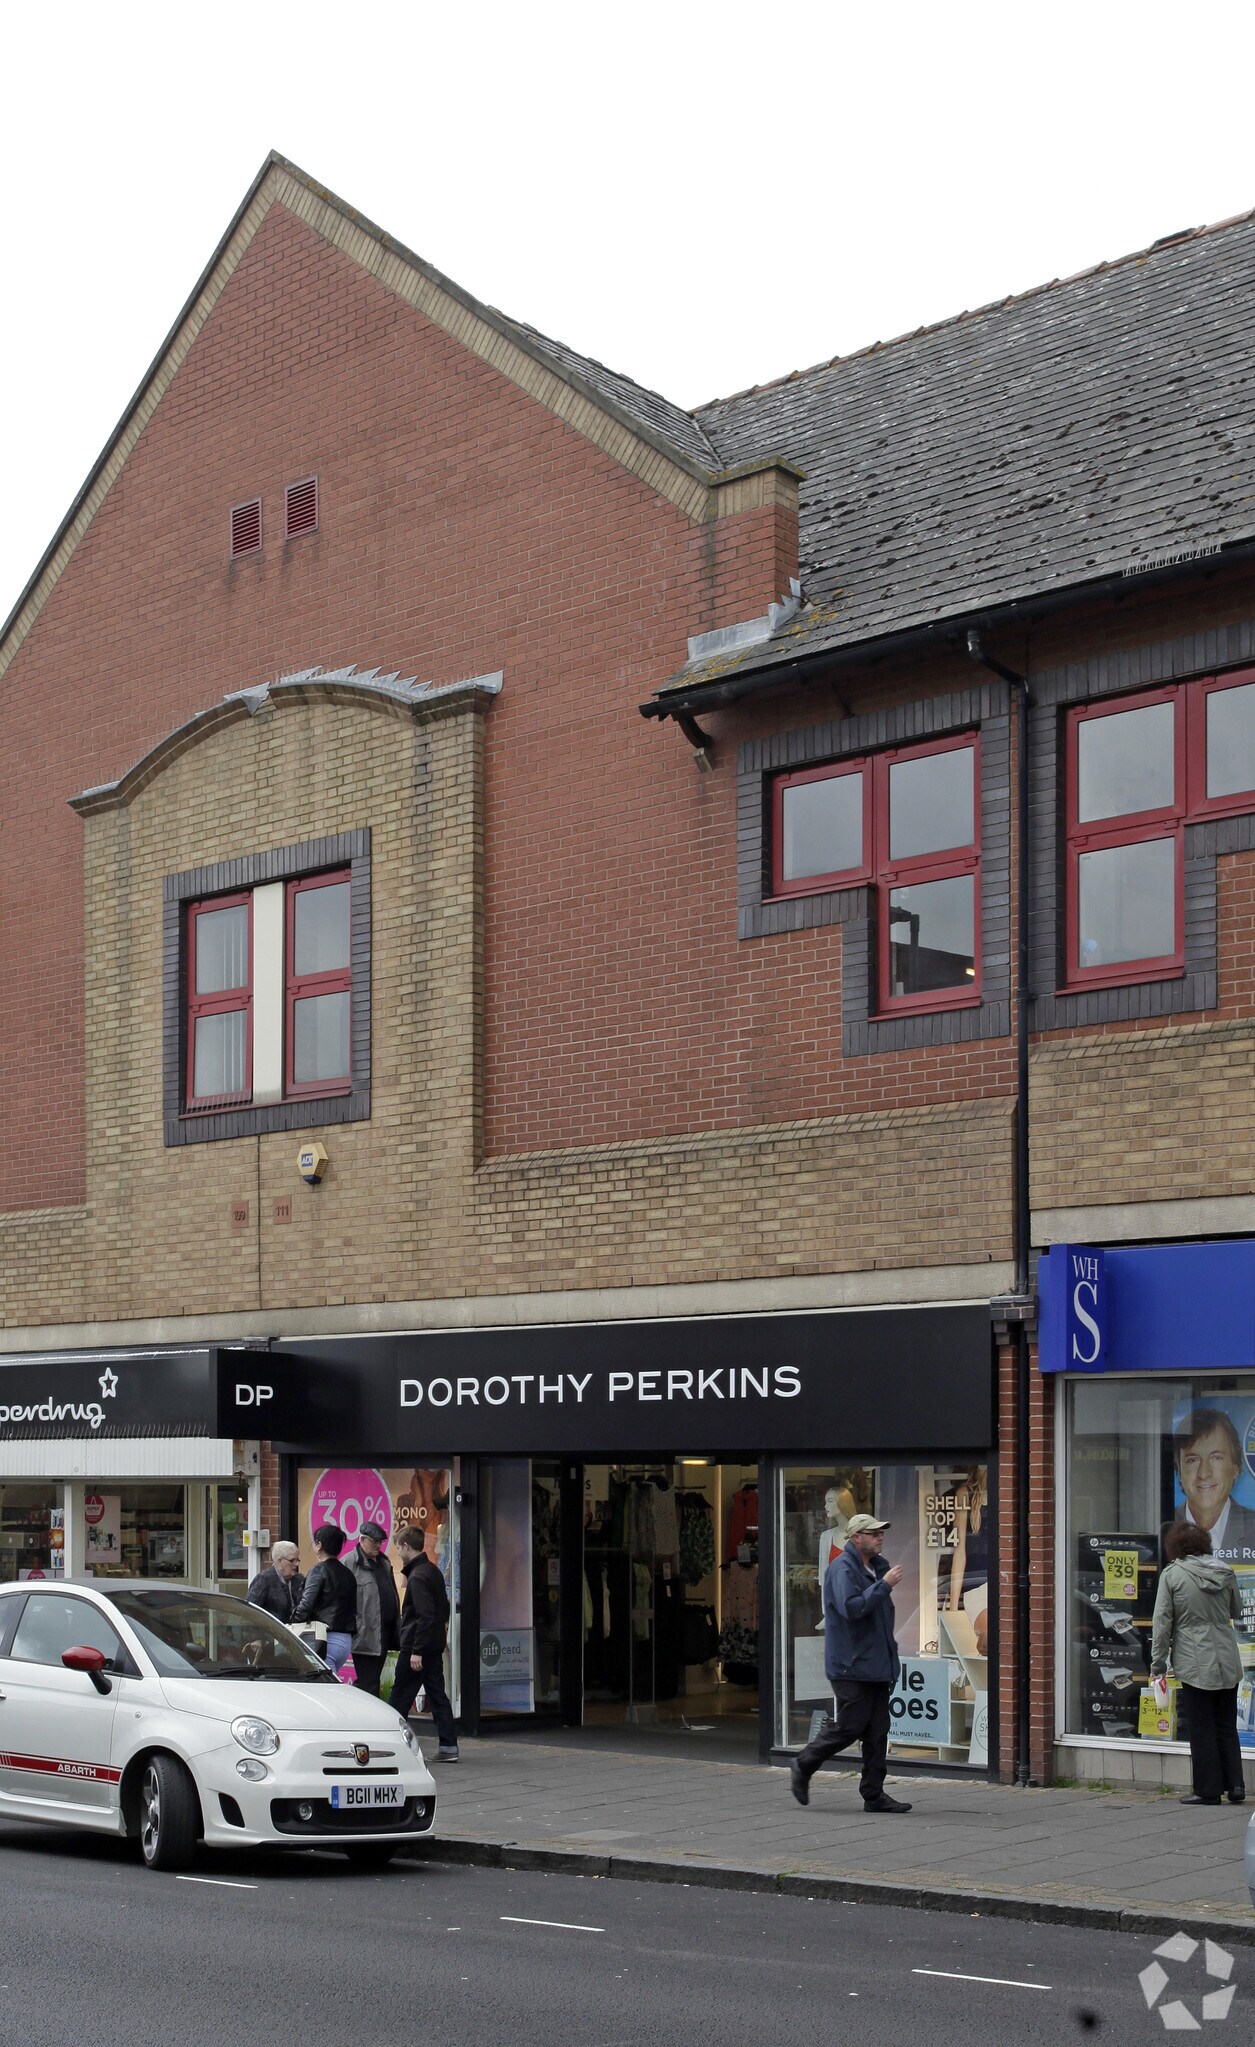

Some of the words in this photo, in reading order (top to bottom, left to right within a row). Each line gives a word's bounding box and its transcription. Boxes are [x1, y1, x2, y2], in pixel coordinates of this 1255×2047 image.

[276, 1205, 289, 1216] 111
[1073, 1255, 1098, 1281] WH
[1073, 1281, 1100, 1363] S
[400, 1373, 593, 1407] DOROTHY
[608, 1365, 801, 1401] PERKINS
[235, 1384, 274, 1406] DP
[318, 1490, 327, 1498] UP
[328, 1490, 337, 1498] TO
[926, 1496, 971, 1510] SHELL
[318, 1496, 386, 1540] 30%
[926, 1512, 955, 1526] TOP
[927, 1527, 960, 1547] £14
[1107, 1556, 1136, 1565] ONLY
[1108, 1565, 1135, 1579] £39
[482, 1643, 499, 1658] gift
[501, 1642, 521, 1655] card
[897, 1663, 925, 1693] le
[57, 1763, 97, 1777] ABARTH
[374, 1786, 398, 1803] MHX
